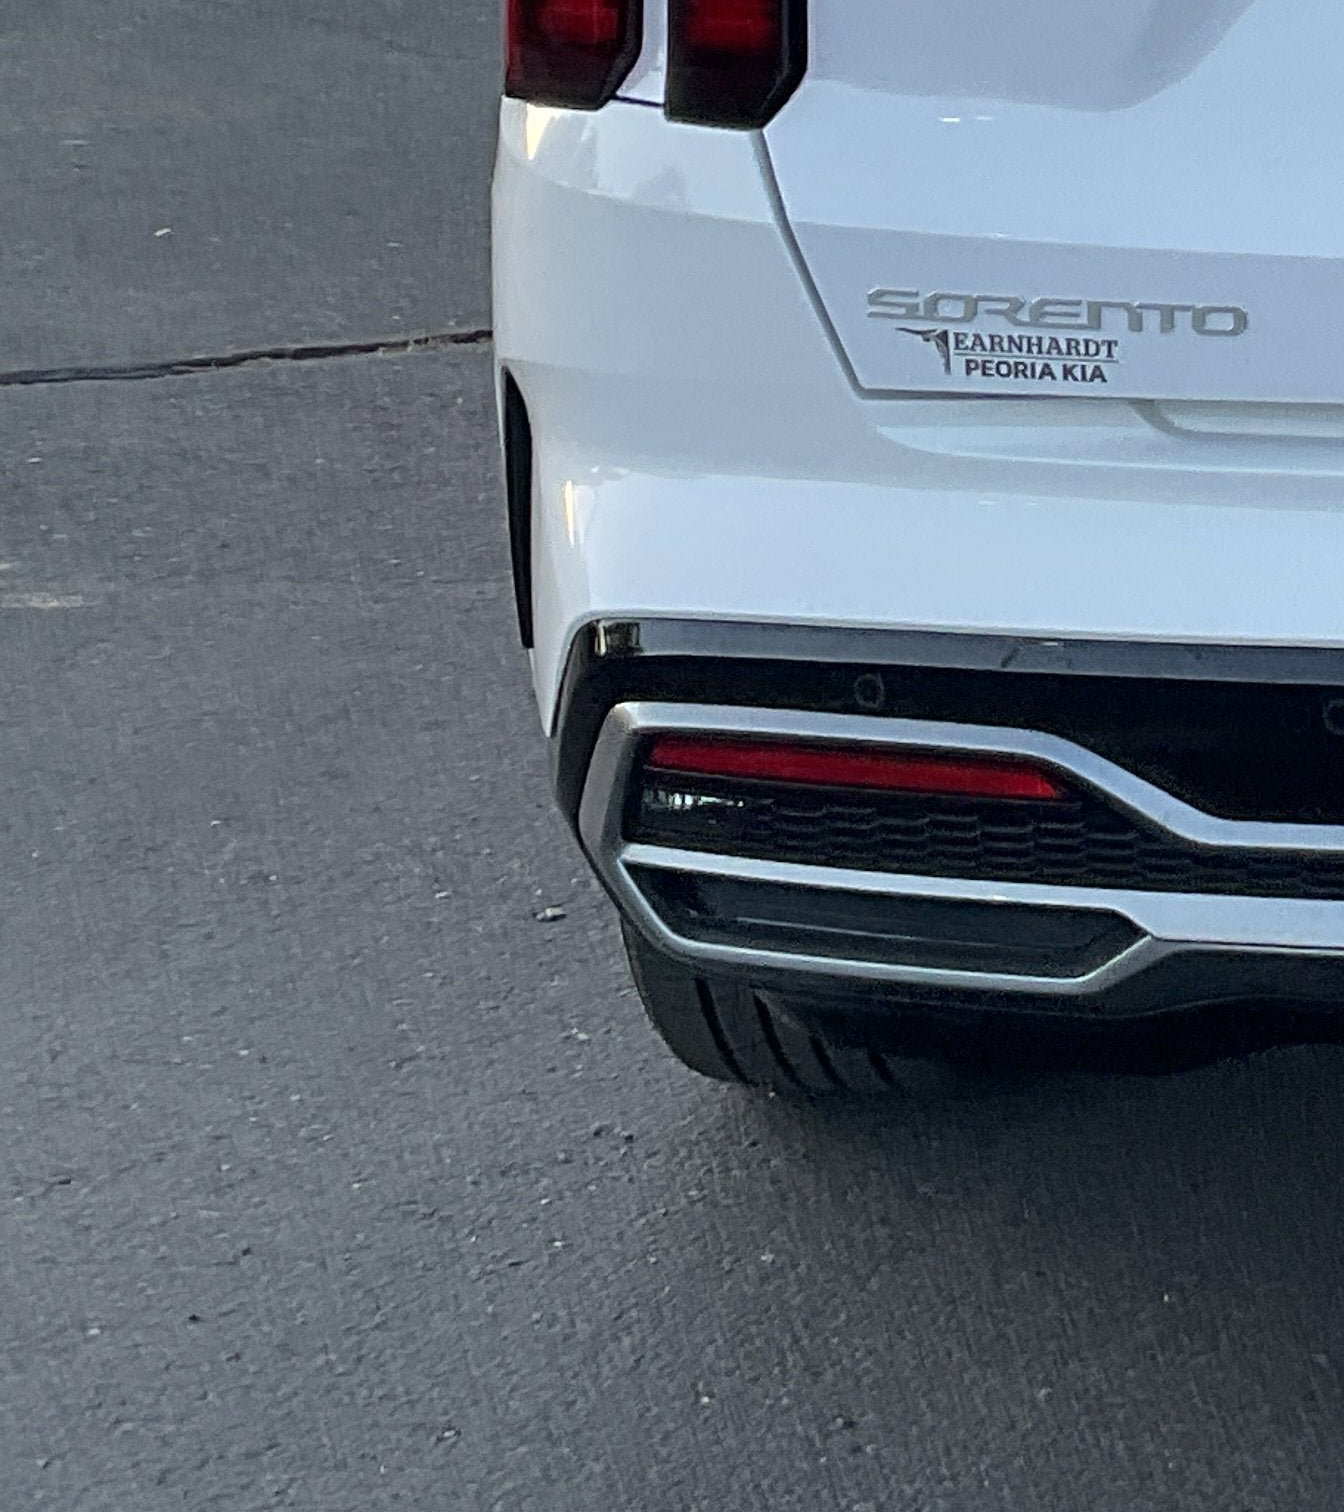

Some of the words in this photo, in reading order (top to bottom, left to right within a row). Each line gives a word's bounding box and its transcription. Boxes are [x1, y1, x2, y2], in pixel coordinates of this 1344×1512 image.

[867, 287, 1249, 337] SORENTO
[953, 331, 1119, 359] EARNHARDT
[965, 357, 1057, 382] PEORIA
[1061, 363, 1108, 383] KIA
